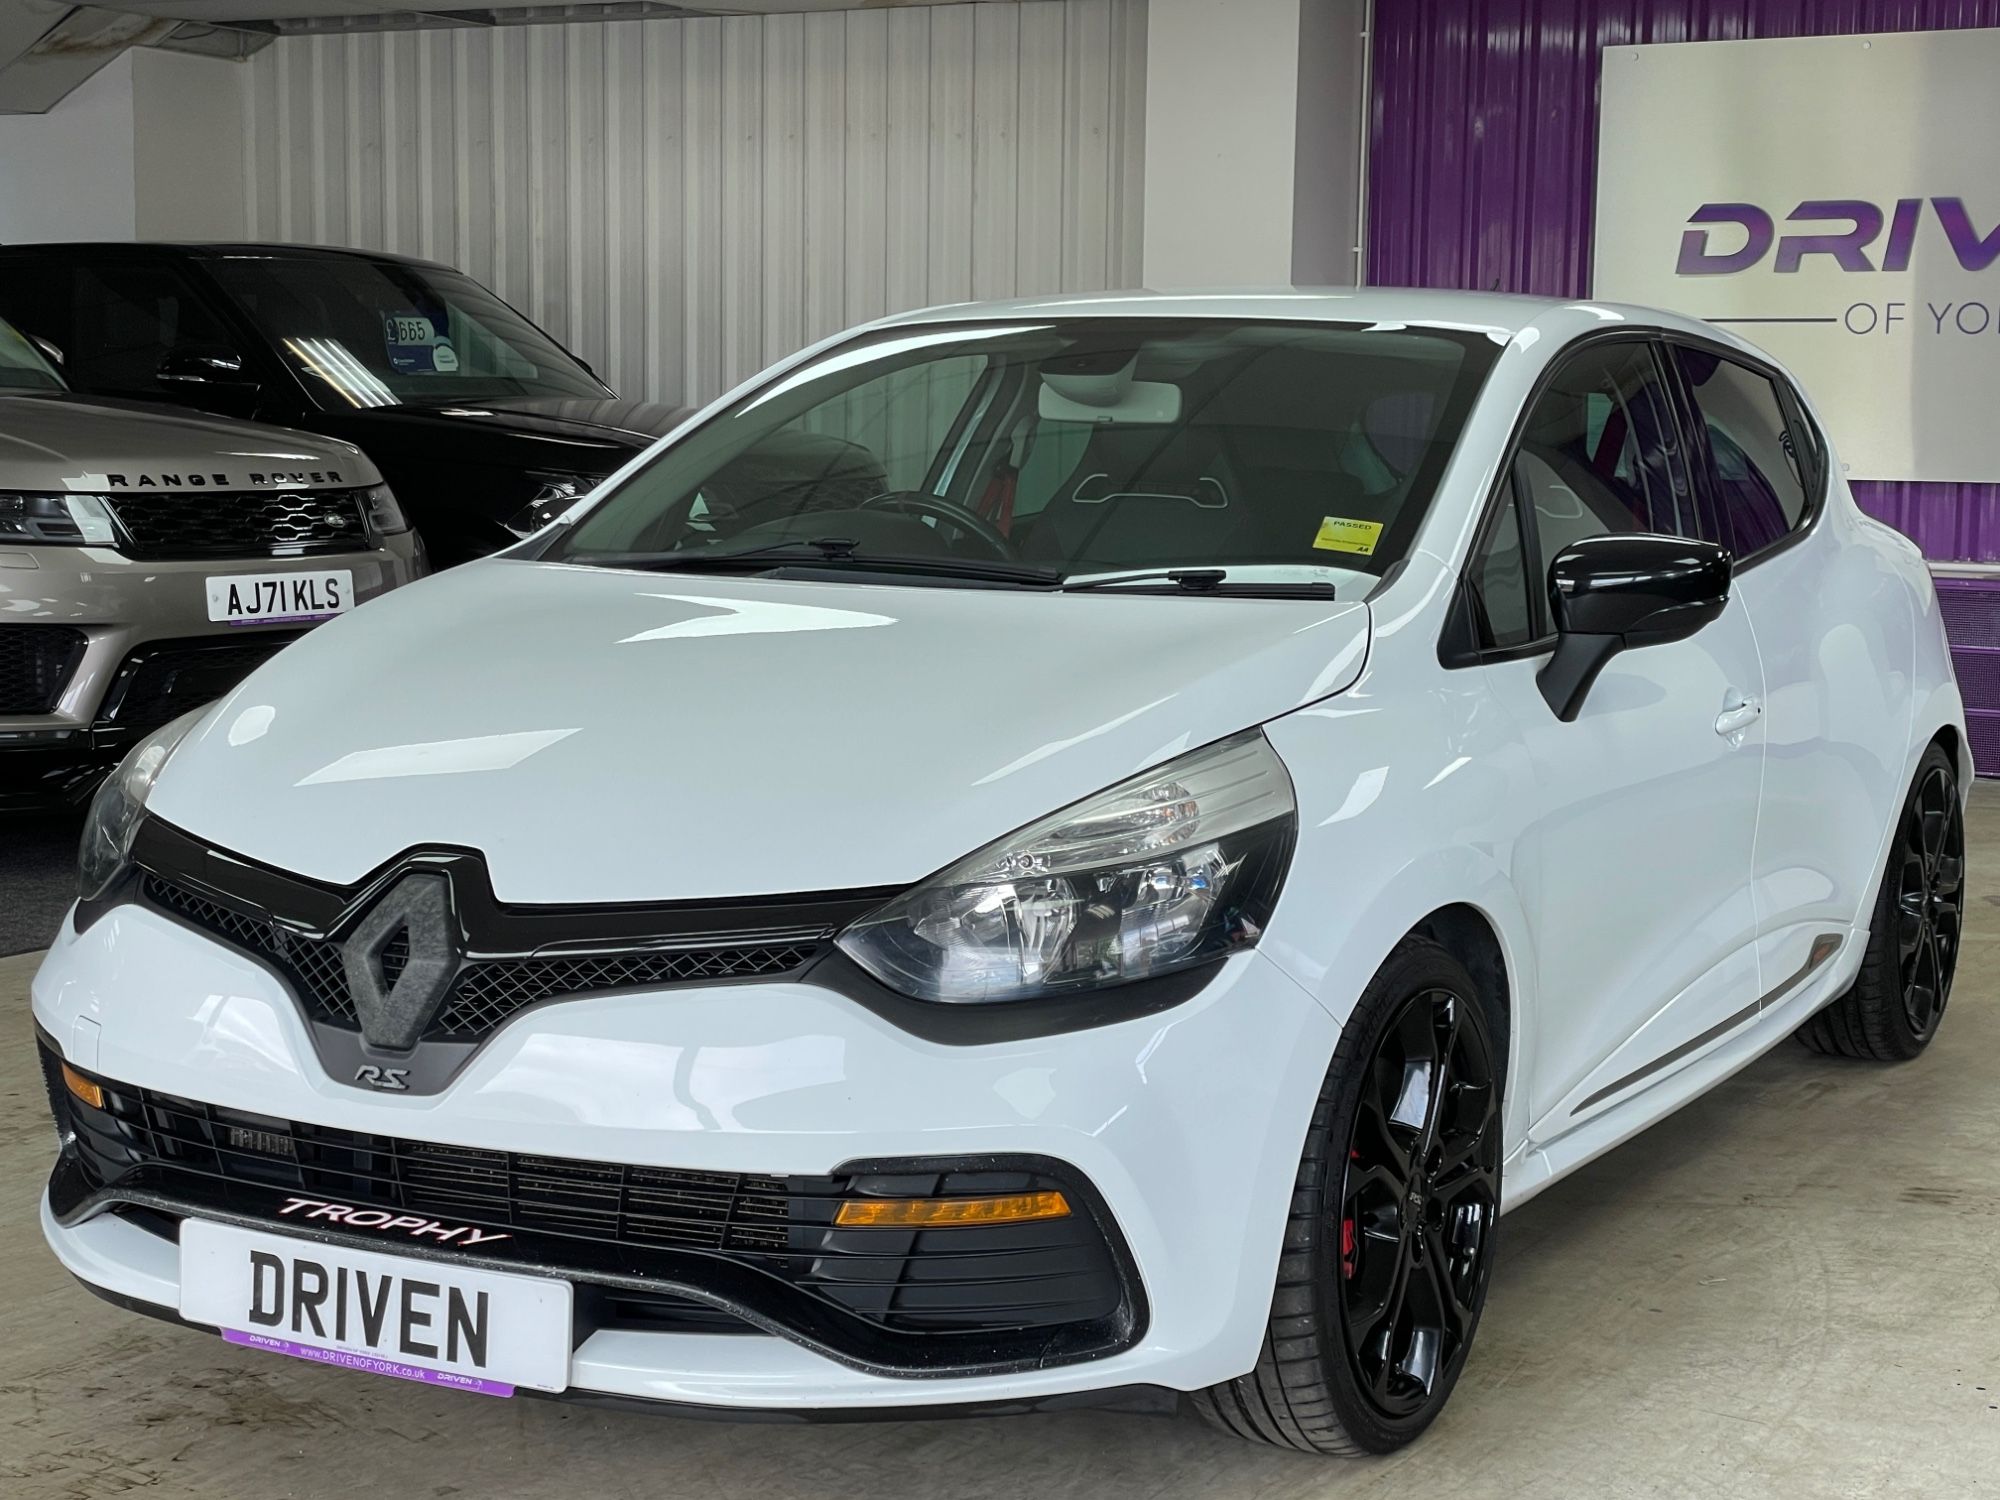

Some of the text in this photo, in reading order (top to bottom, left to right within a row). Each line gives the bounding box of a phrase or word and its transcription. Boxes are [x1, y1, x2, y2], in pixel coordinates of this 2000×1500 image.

[1675, 197, 2000, 275] DRIV
[1844, 301, 2000, 335] OF YO
[106, 471, 344, 487] RANGE ROVER
[1333, 520, 1372, 530] PASSED
[227, 578, 340, 616] AJ71 KLS
[354, 1065, 410, 1090] RS
[279, 1197, 512, 1246] TROPHY
[248, 1250, 489, 1368] DRIVEN
[249, 1335, 281, 1348] DRIVEN
[300, 1347, 426, 1380] www.DRIVENOFYORK.co.uk
[436, 1371, 473, 1385] DRIVEN
